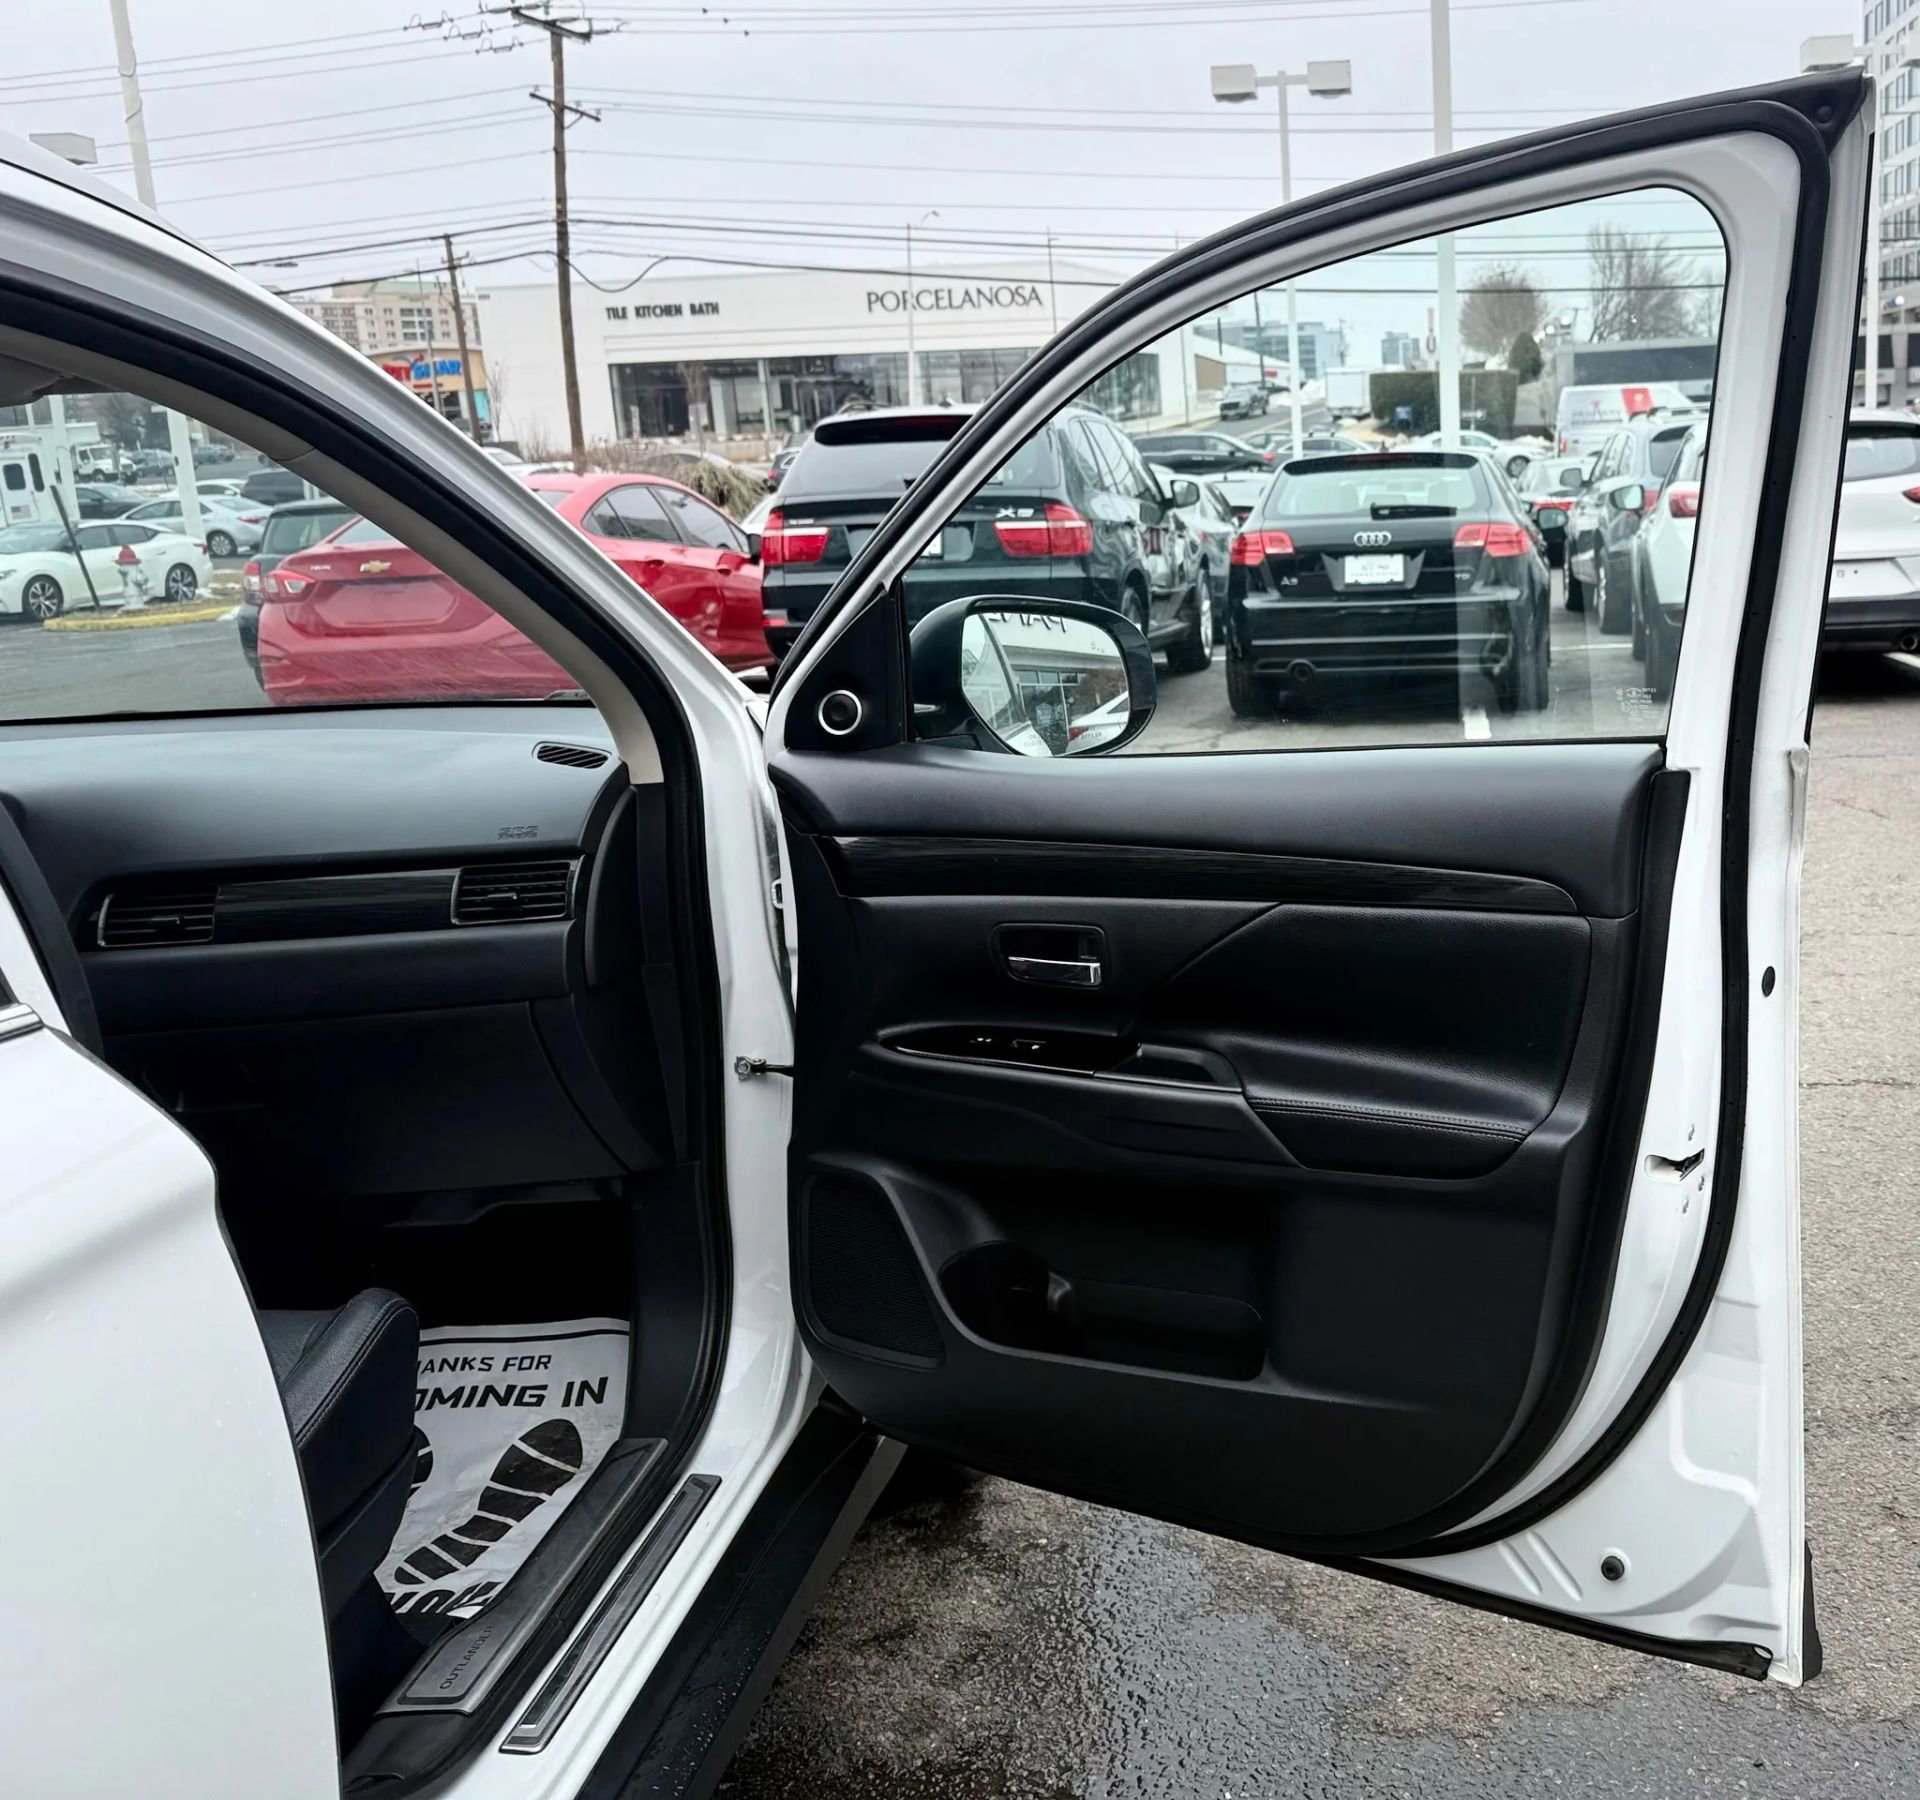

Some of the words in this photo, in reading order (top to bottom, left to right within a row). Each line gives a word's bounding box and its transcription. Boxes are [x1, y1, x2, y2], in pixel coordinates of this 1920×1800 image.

[605, 306, 628, 320] TILE
[634, 303, 683, 319] KITCHEN
[689, 301, 720, 316] BATH
[866, 285, 1043, 313] PORCELANOSA
[417, 1356, 494, 1375] ANKS
[502, 1355, 551, 1372] FOR
[414, 1385, 548, 1412] MING
[561, 1376, 609, 1408] IN
